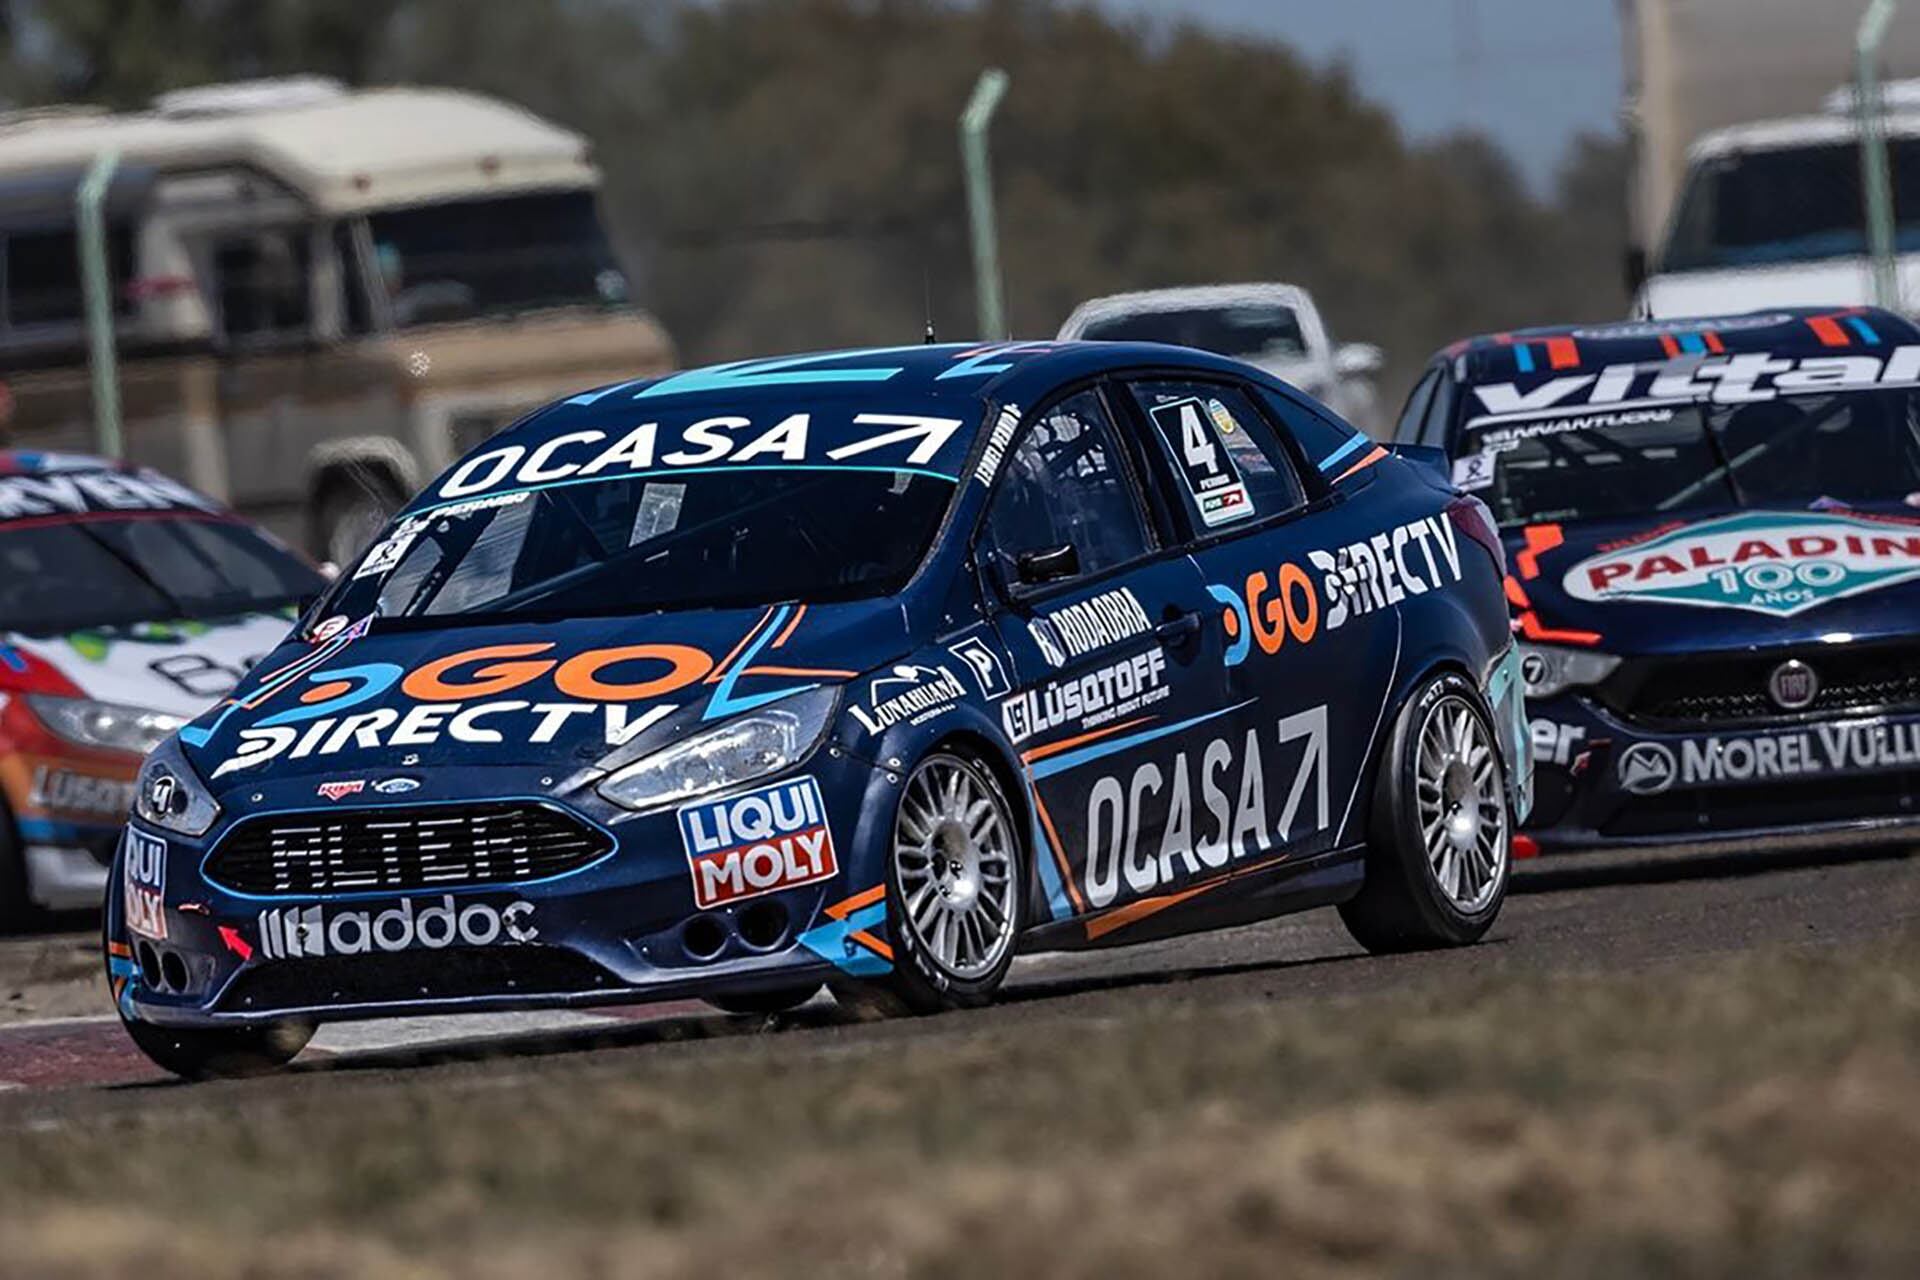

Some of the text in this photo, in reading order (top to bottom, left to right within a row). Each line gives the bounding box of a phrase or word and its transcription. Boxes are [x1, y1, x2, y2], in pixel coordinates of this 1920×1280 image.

[438, 413, 809, 499] OCASA
[1180, 404, 1219, 474] 4
[1709, 560, 1846, 595] 100
[964, 647, 994, 689] P
[1525, 659, 1542, 683] 7
[211, 700, 680, 780] DIRECTV
[1681, 733, 1822, 783] MOREL
[152, 784, 171, 813] 4
[688, 782, 819, 852] LIQUI
[1084, 727, 1271, 909] OCASA
[698, 829, 827, 901] MOLY
[329, 894, 539, 954] addoc
